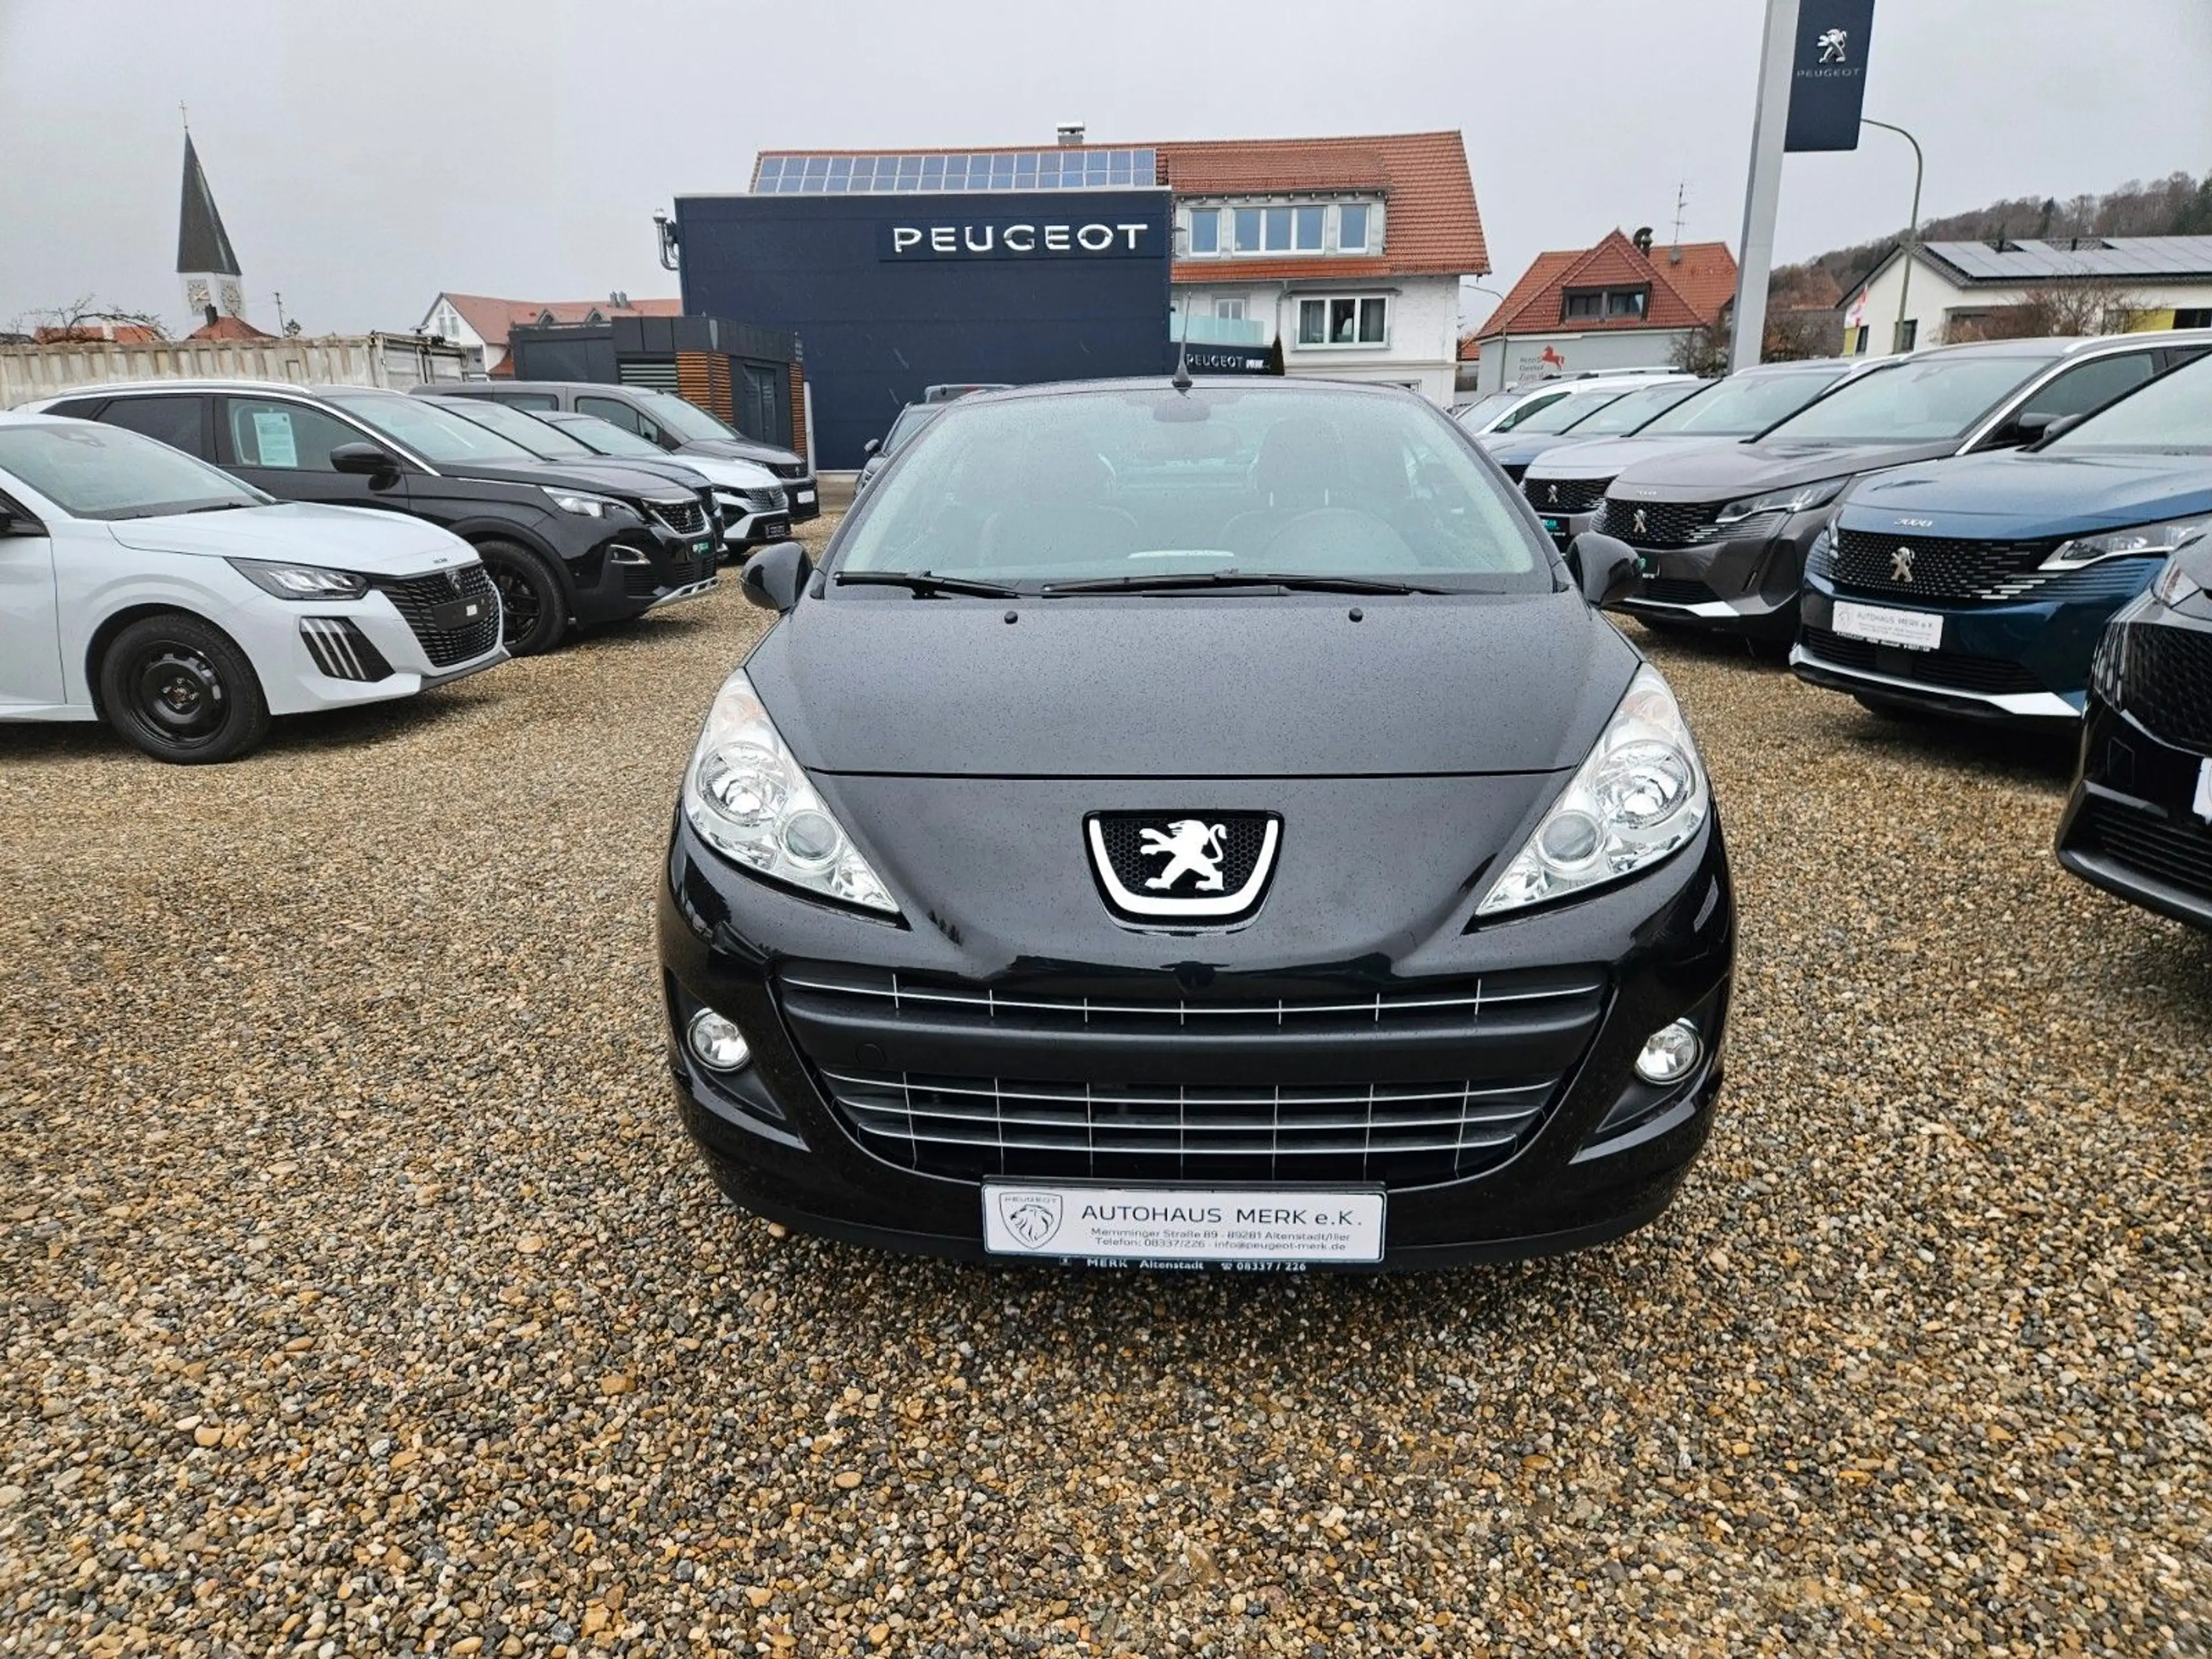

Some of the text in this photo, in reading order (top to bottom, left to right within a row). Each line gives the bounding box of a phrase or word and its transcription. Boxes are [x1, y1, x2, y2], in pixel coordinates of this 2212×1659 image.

[1797, 68, 1861, 78] PEUGEOT
[893, 224, 1147, 253] PEUGEOT
[1186, 354, 1243, 368] PEUGEOT
[1082, 1205, 1362, 1226] AUTOHAUS MERK e.K.
[1092, 1228, 1159, 1238] Memminger
[1162, 1230, 1201, 1238] Straße
[1204, 1230, 1218, 1238] 89
[1228, 1231, 1262, 1239] 89281
[1096, 1237, 1346, 1251] Telefon: 08337/226 info@peugeot-merk.de
[1086, 1259, 1127, 1268] MERK
[1139, 1259, 1203, 1270] Altenstadt
[1237, 1262, 1272, 1271] 08337
[1285, 1262, 1306, 1271] 226
